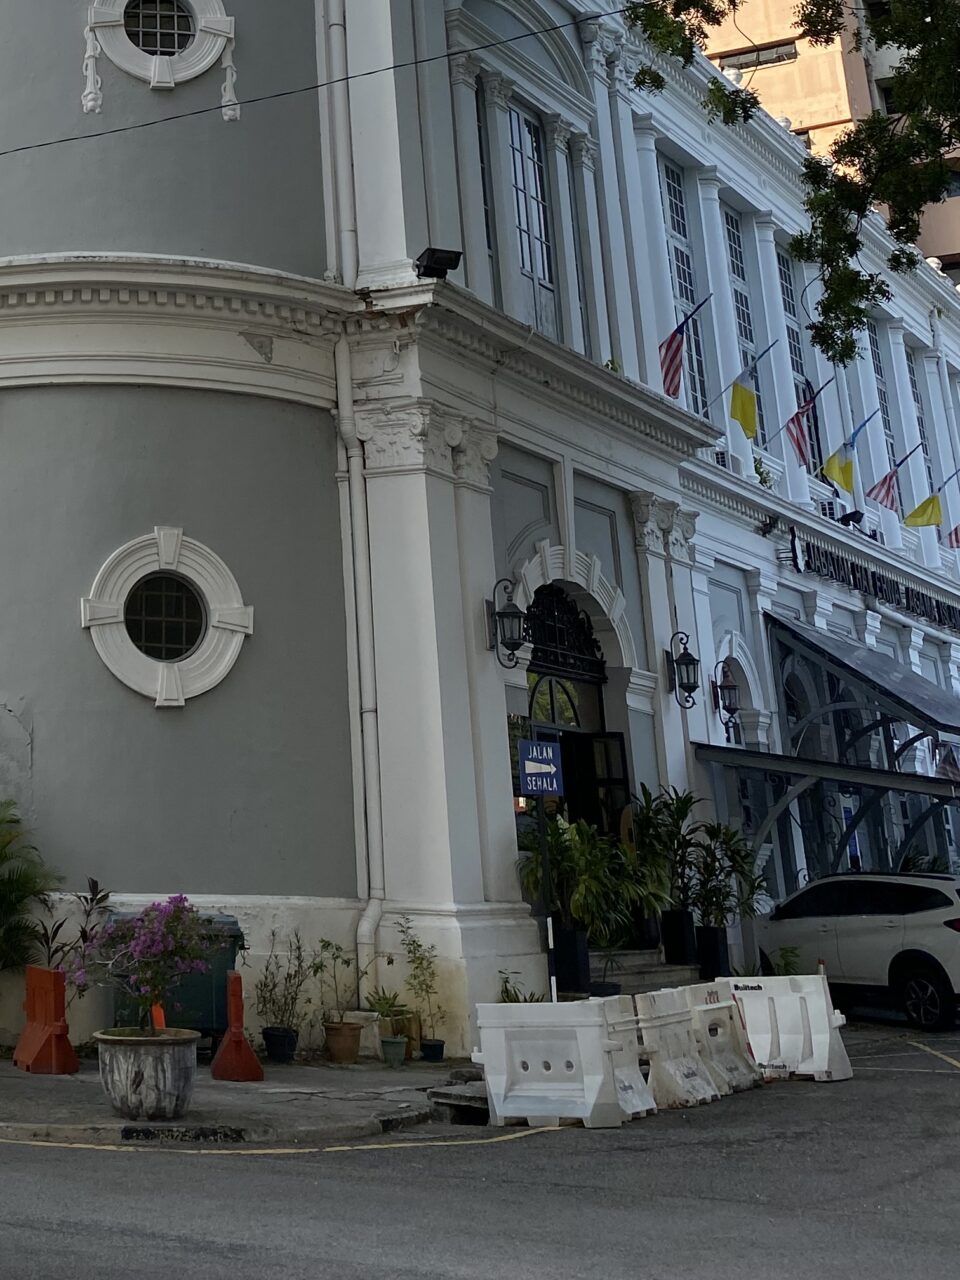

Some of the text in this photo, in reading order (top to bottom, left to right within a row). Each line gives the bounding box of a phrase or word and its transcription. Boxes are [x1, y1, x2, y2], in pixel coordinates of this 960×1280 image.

[806, 543, 852, 585] JABATAN
[528, 746, 553, 759] JALAN
[527, 777, 558, 791] SEHALA
